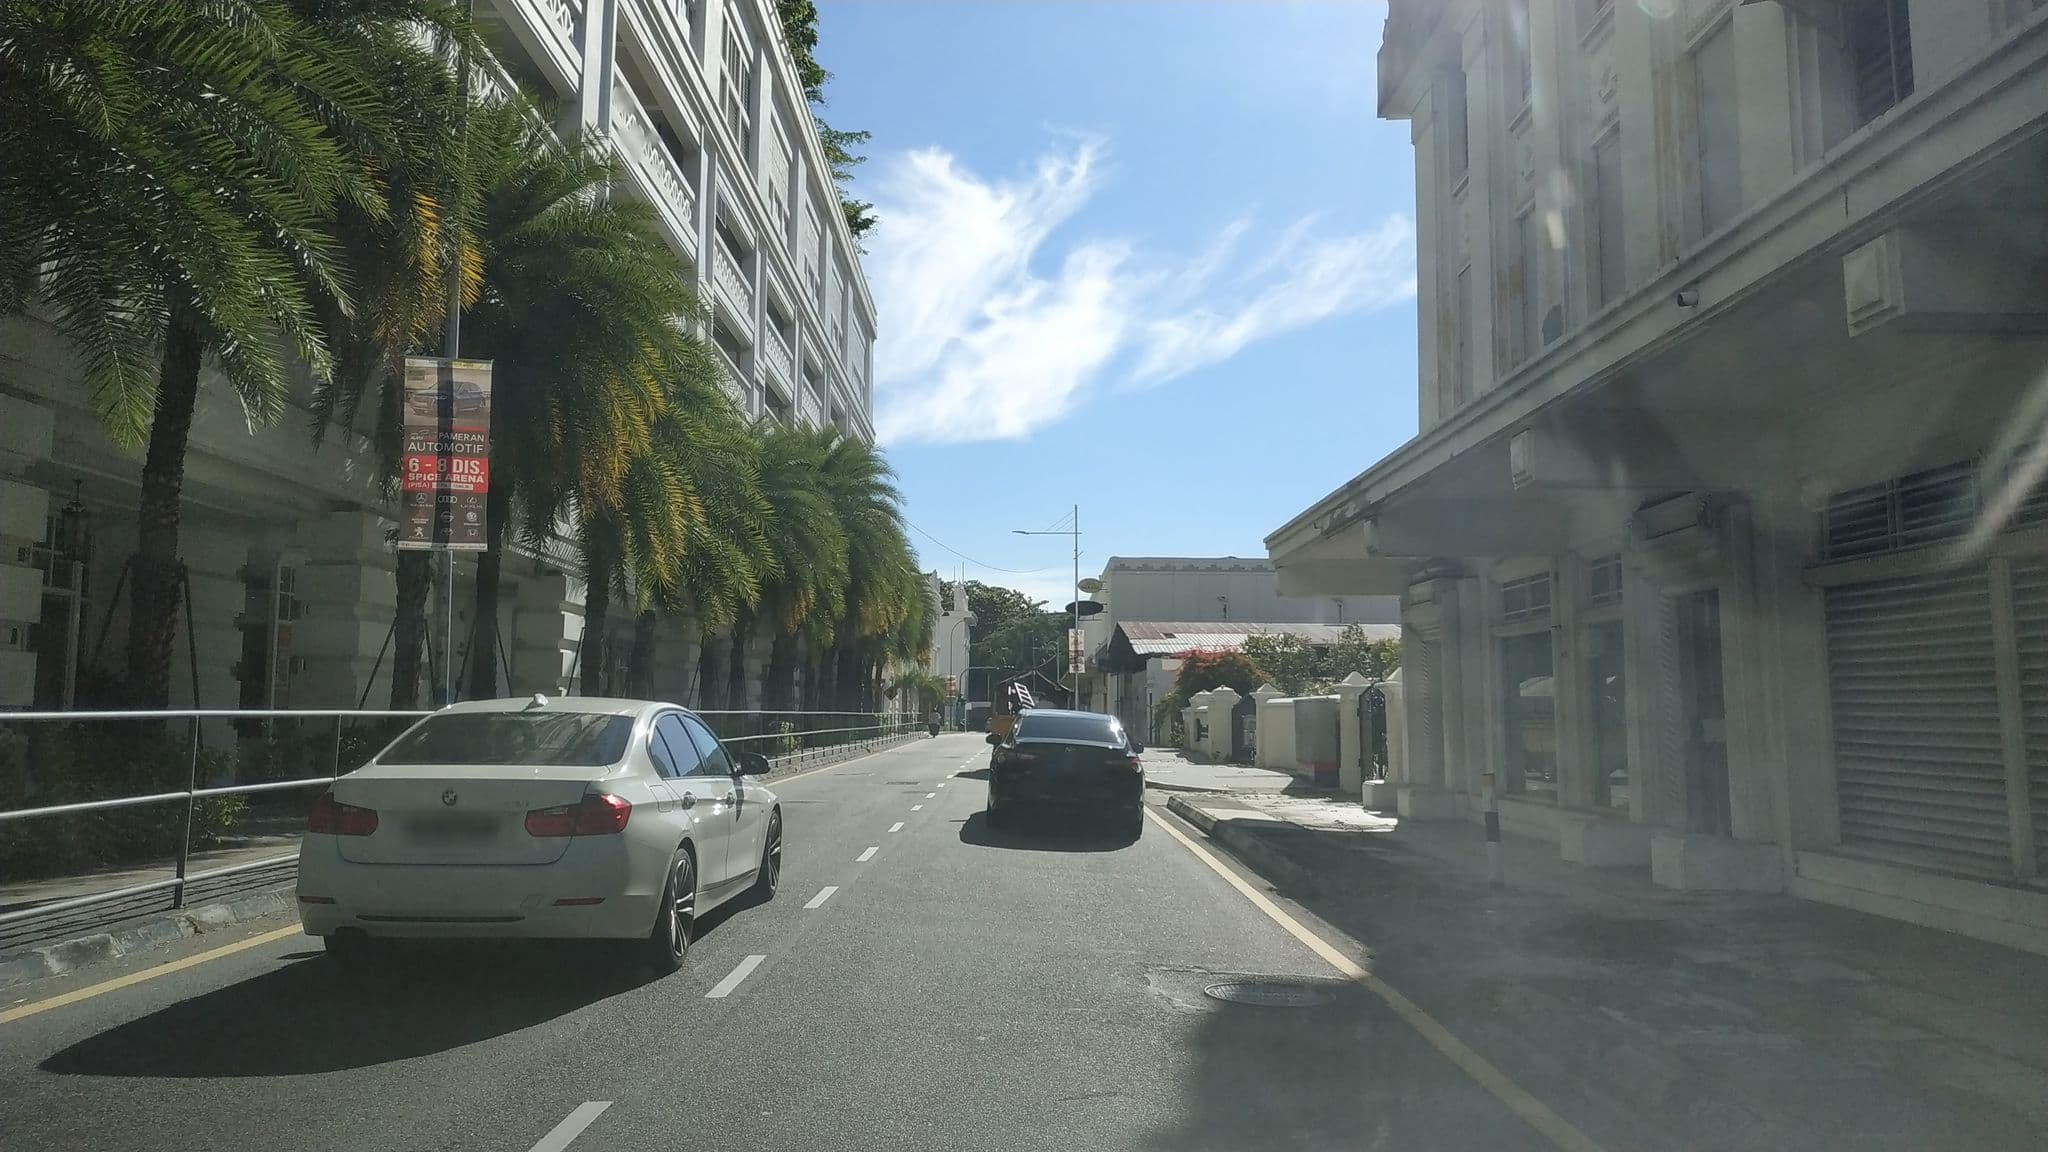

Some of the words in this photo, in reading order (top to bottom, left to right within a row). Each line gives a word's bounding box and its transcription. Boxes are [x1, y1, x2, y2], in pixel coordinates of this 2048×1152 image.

[439, 432, 484, 442] PAMERAN
[407, 442, 484, 453] AUTOMOTIF
[408, 458, 419, 472] 6
[437, 458, 447, 472] 8
[452, 459, 485, 475] DIS.
[408, 473, 441, 481] SPICE
[445, 474, 484, 483] ARENA
